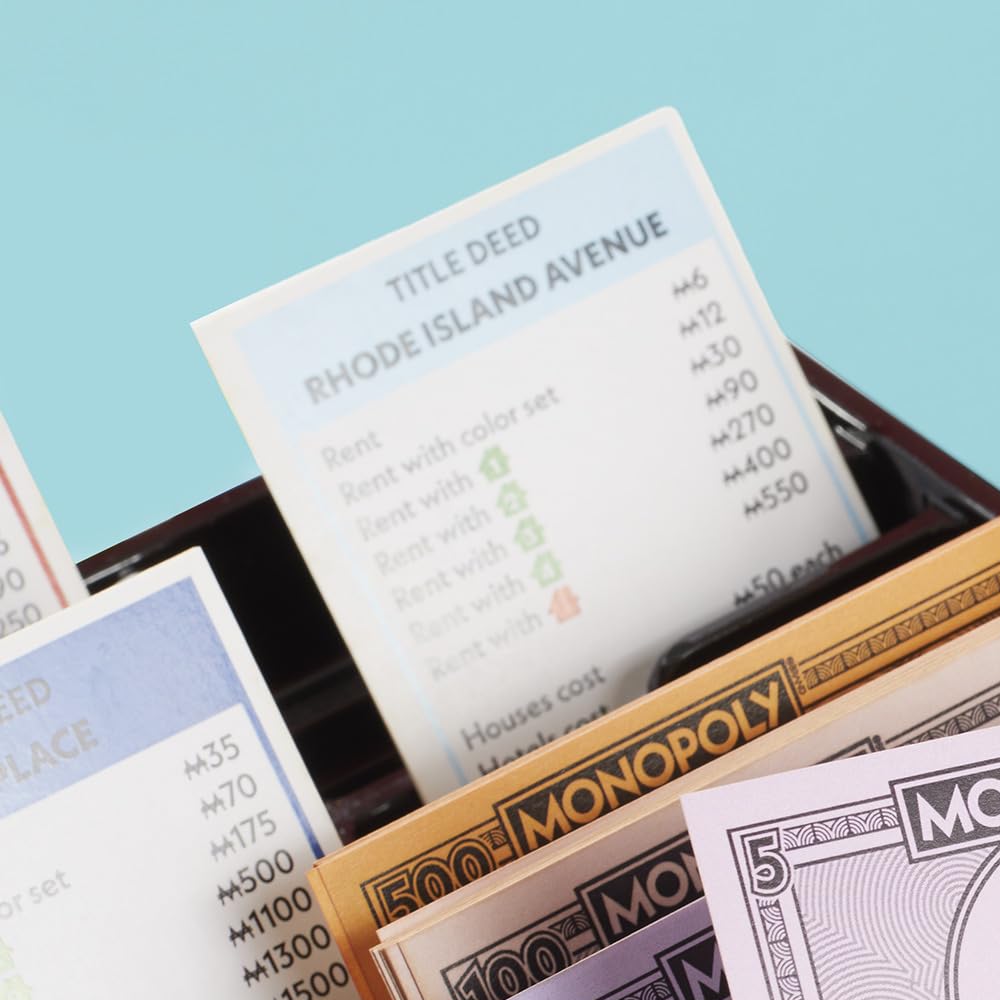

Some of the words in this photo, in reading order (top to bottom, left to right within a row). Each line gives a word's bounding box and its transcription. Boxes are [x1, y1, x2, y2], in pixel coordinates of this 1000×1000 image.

[385, 248, 468, 303] TITLE
[468, 213, 542, 266] DEED
[304, 329, 421, 406] RHODE
[421, 274, 538, 348] ISLAND
[543, 210, 669, 292] AVENUE
[321, 429, 383, 471] Rent
[337, 465, 400, 506] Rent
[401, 433, 457, 475] with
[459, 406, 518, 448] color
[522, 385, 561, 417] set
[356, 500, 417, 542] Rent
[418, 470, 475, 510] with
[437, 504, 493, 544] with
[453, 539, 509, 579] with
[460, 692, 554, 752] Houses
[556, 665, 607, 703] cost
[517, 680, 781, 851] MONOPOLY
[377, 839, 497, 928] 500
[742, 828, 792, 899] 5
